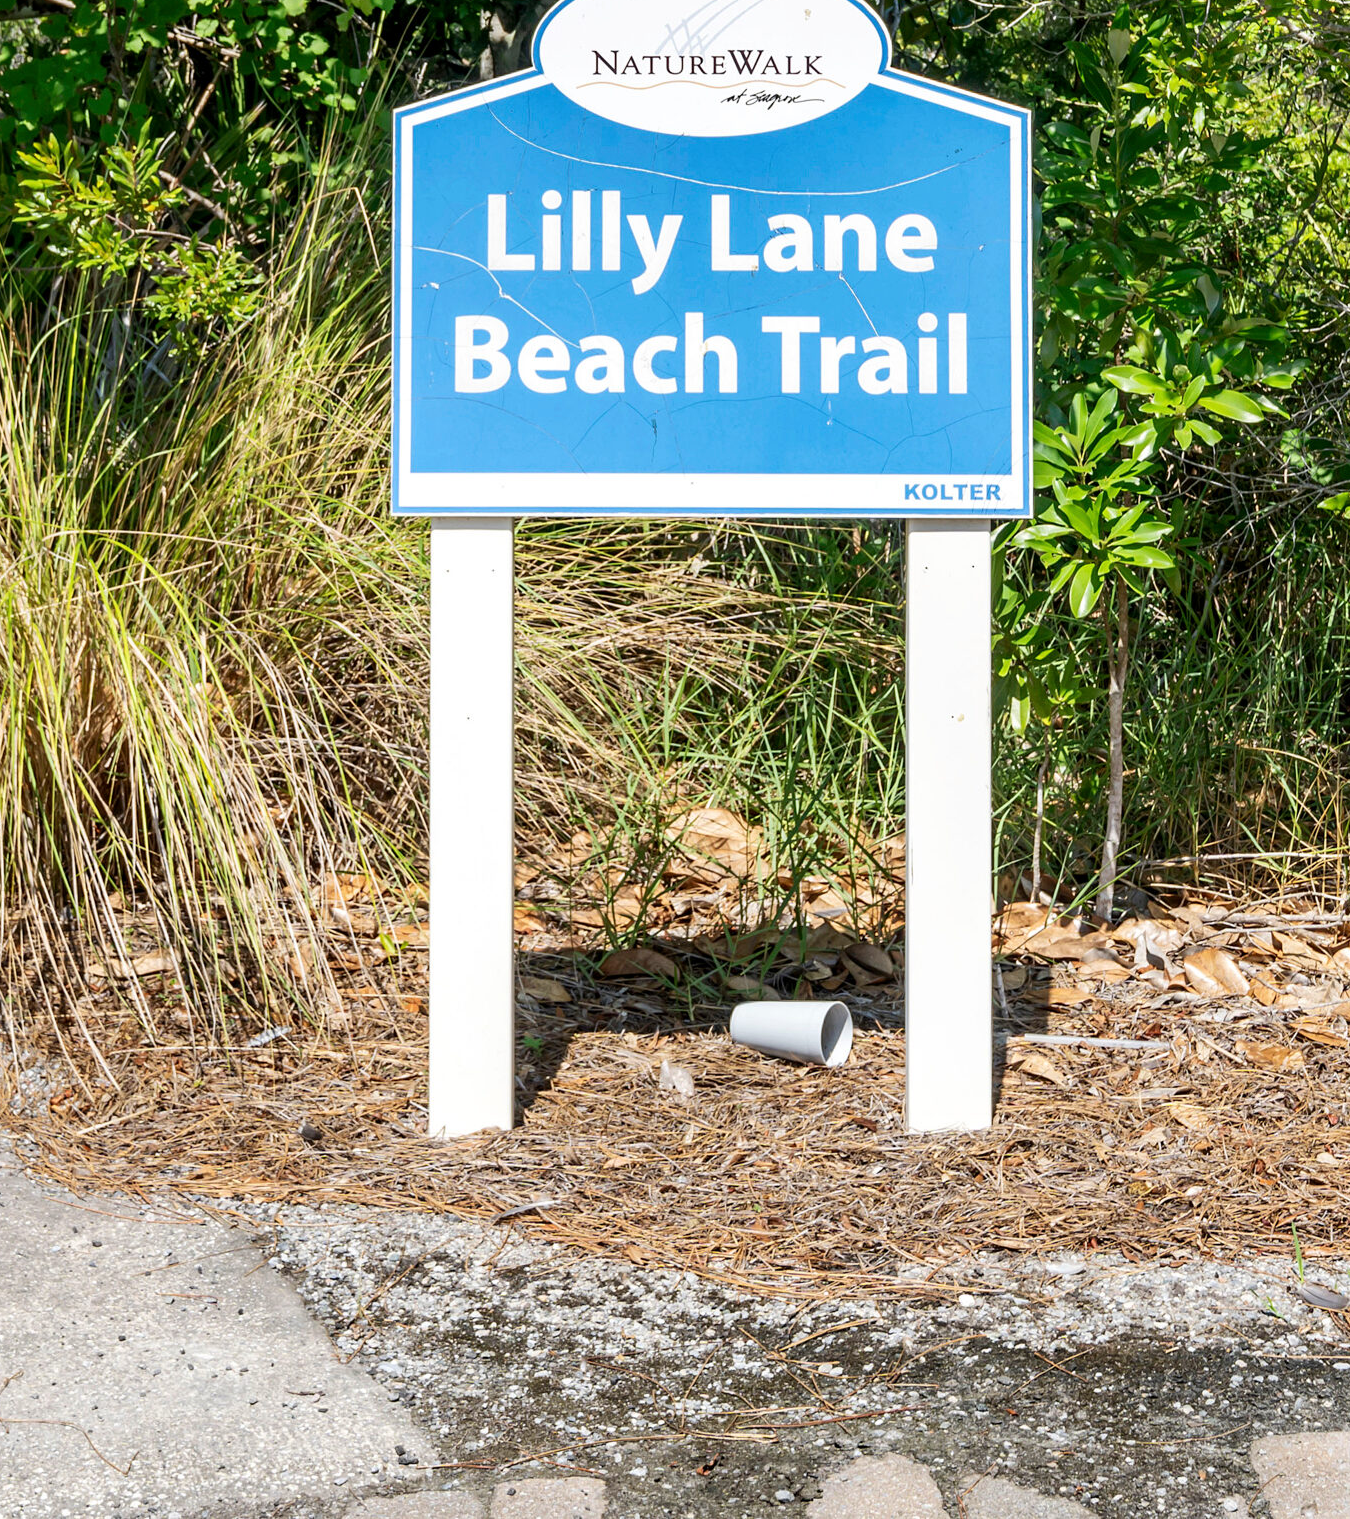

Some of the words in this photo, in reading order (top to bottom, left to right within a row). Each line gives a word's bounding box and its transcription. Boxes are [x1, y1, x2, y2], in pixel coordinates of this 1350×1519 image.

[720, 88, 748, 104] at
[486, 189, 684, 295] Lilly
[710, 193, 939, 274] Lane
[453, 311, 738, 395] Beach
[761, 311, 968, 395] Trail
[904, 483, 1001, 501] KOLTER
